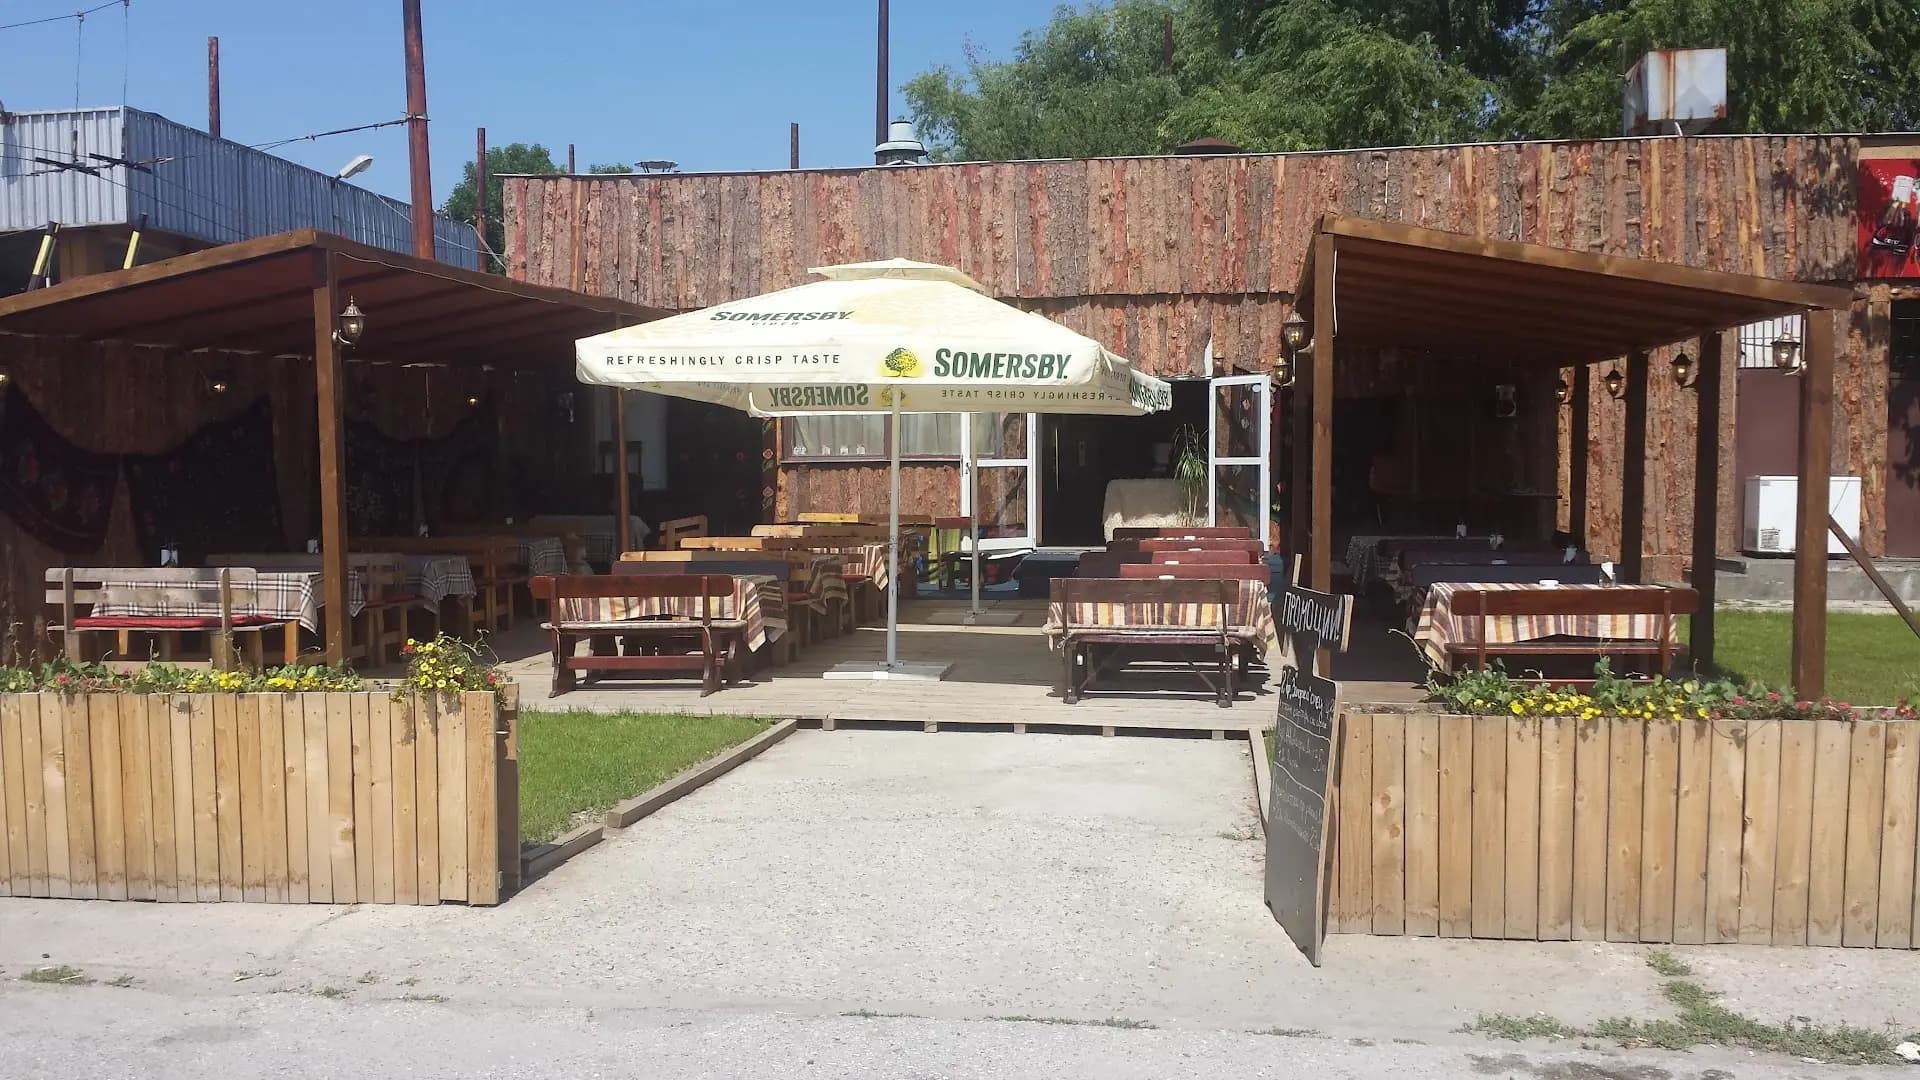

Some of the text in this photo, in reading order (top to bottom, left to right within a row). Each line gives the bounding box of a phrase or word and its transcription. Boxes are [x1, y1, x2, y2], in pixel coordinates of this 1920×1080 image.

[606, 354, 841, 366] REFRESHINGLY CRISP TASTE
